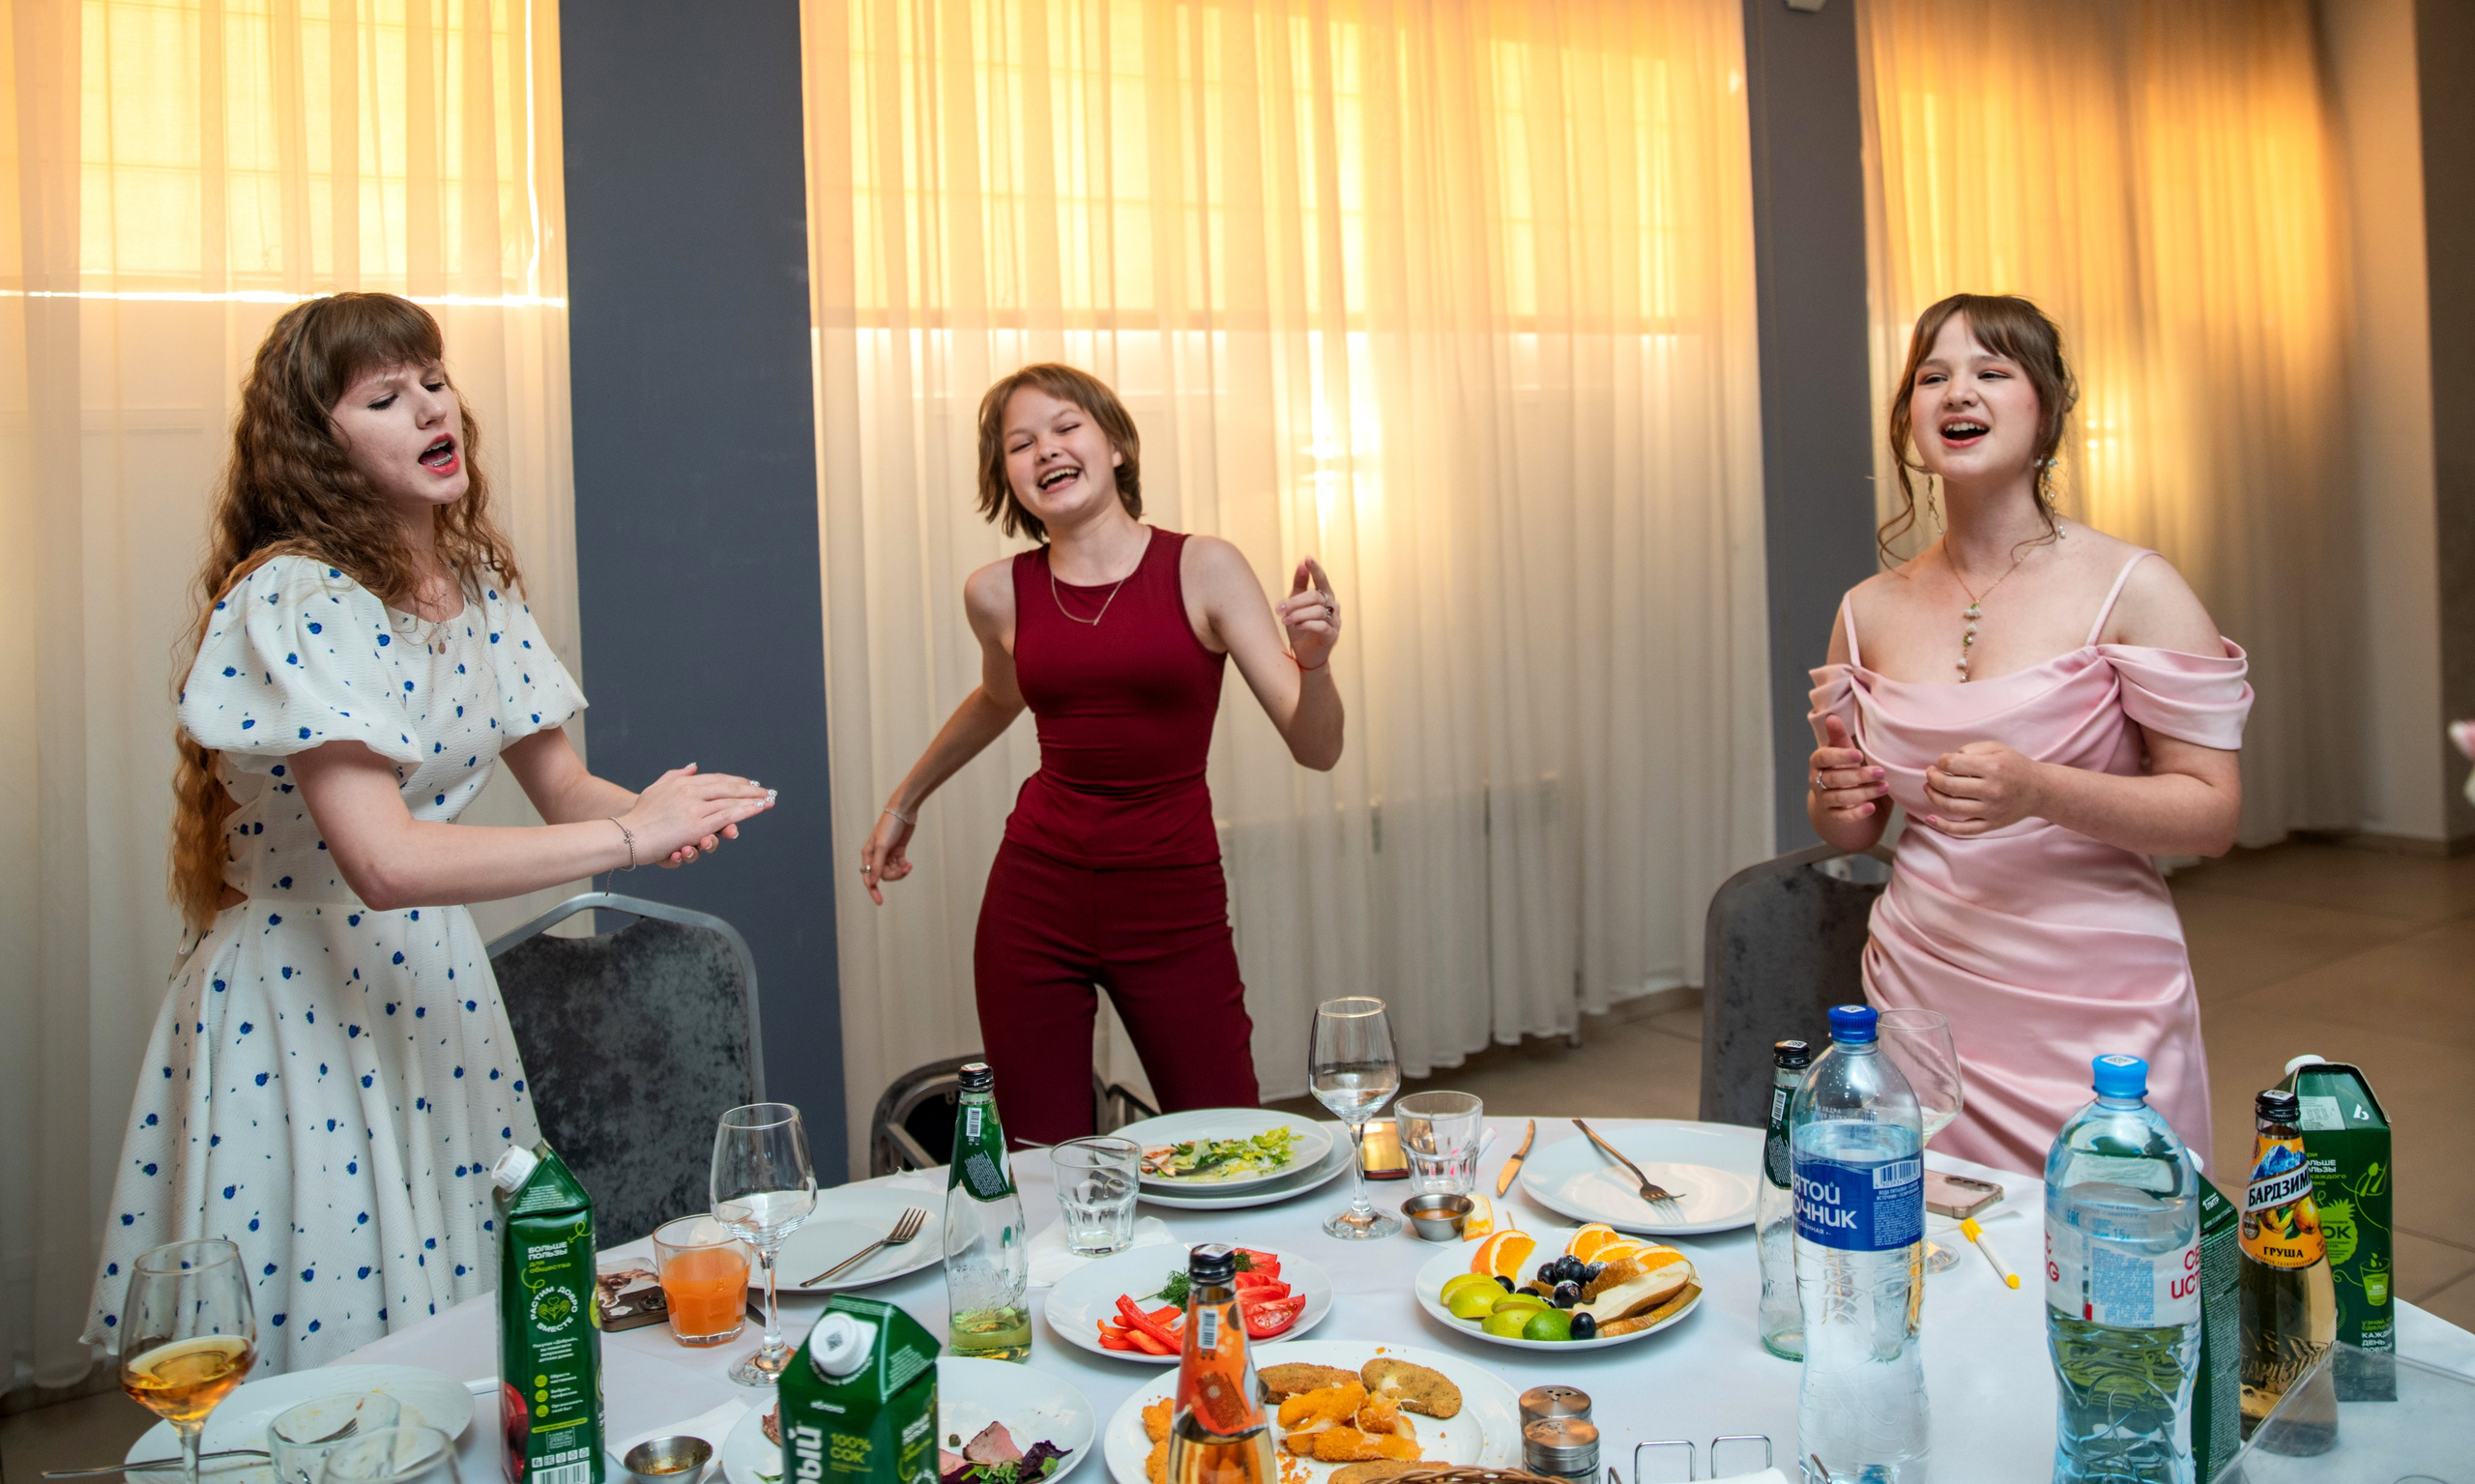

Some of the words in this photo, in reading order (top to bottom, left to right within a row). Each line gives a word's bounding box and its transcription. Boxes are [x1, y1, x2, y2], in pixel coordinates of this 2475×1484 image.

[2322, 1225, 2352, 1239] ОК
[528, 1241, 568, 1254] БОЛЬШЕ
[528, 1249, 568, 1261] ПОЛЬЗЫ
[2263, 1246, 2304, 1258] ГРУША
[530, 1286, 555, 1321] РАСТИМ
[557, 1286, 578, 1314] ДОБРО
[537, 1316, 574, 1333] ВМЕСТЕ
[830, 1432, 873, 1452] 100%
[830, 1446, 865, 1465] СОК
